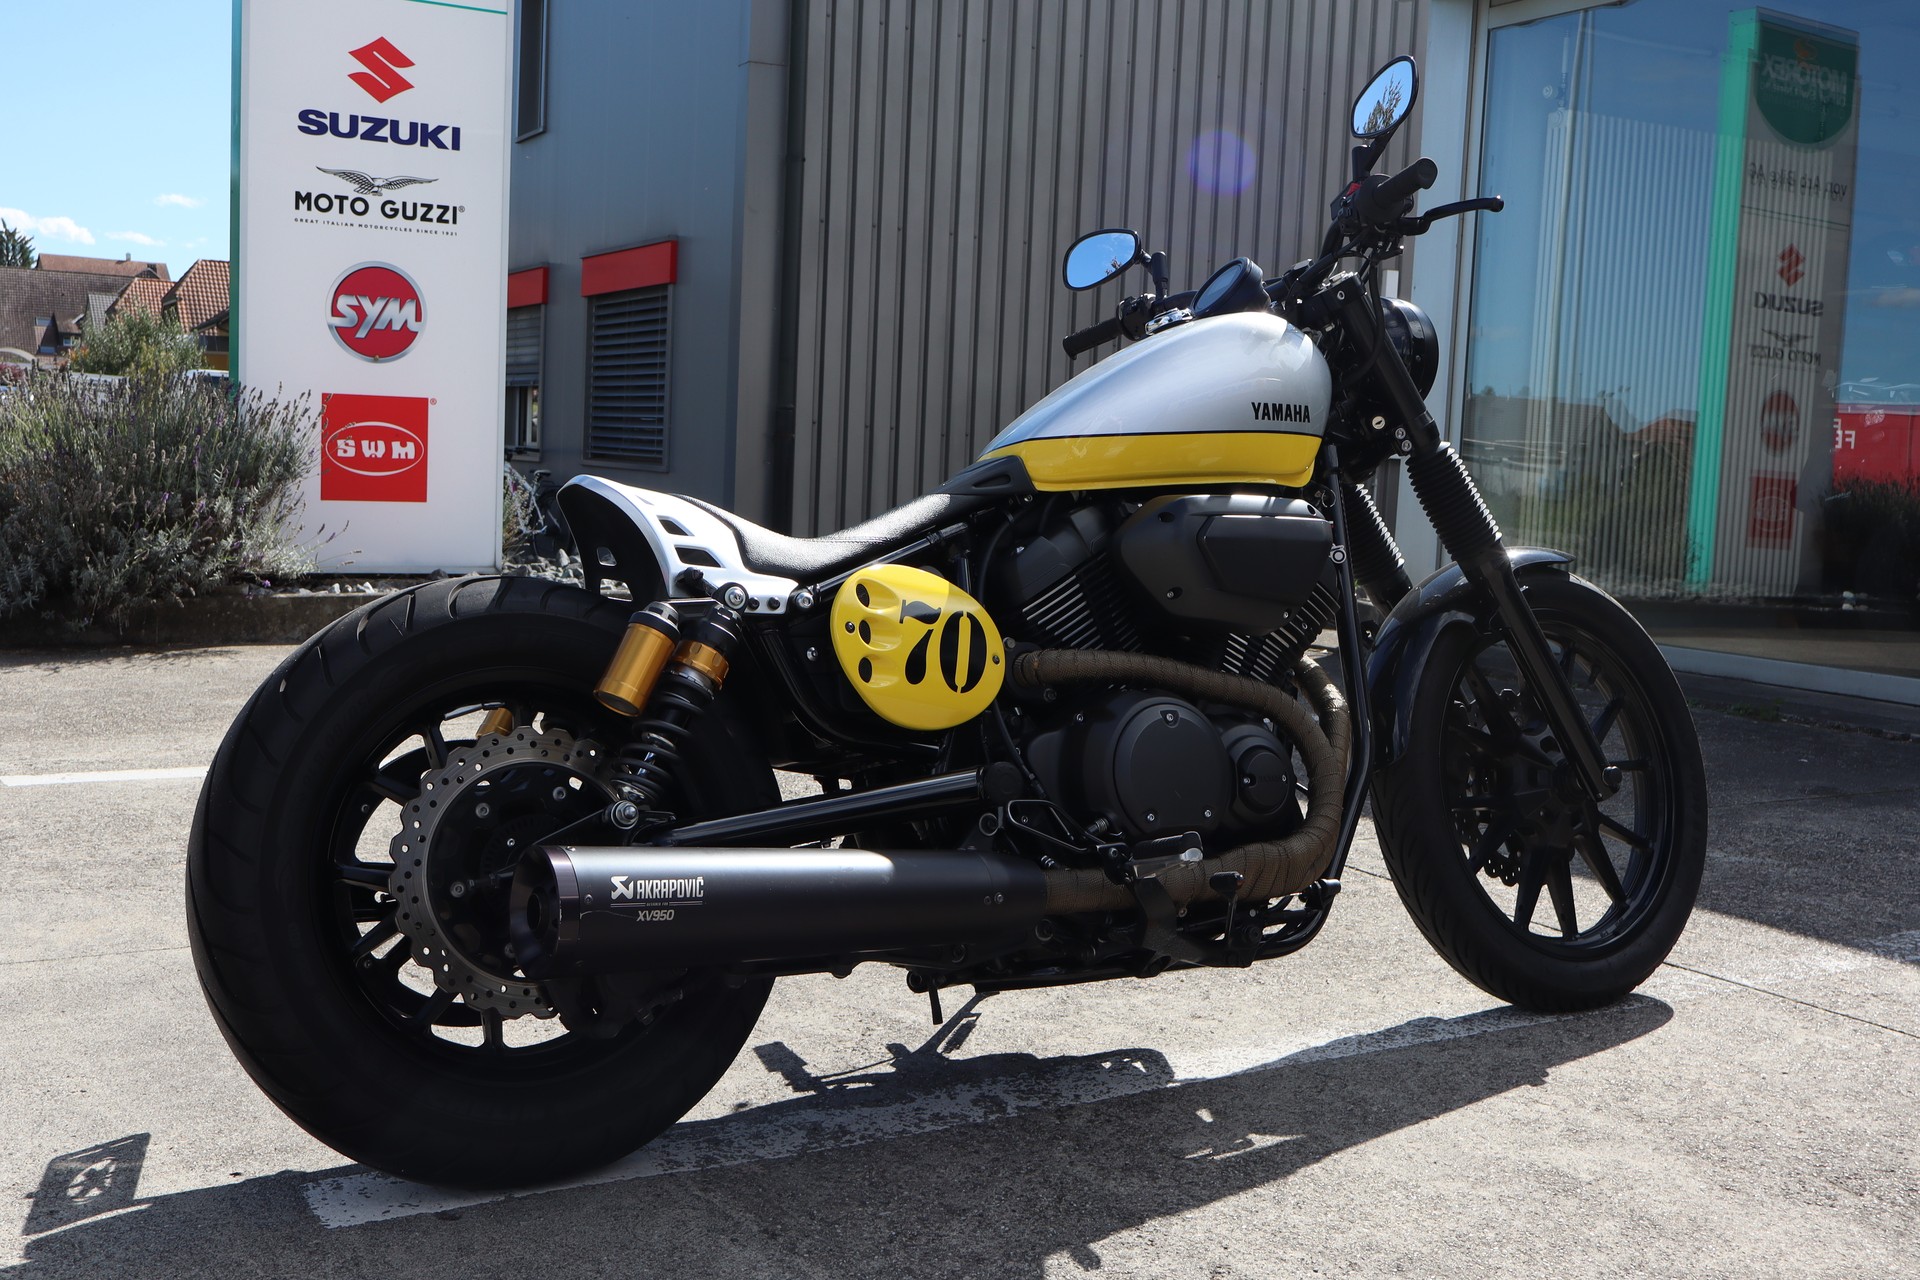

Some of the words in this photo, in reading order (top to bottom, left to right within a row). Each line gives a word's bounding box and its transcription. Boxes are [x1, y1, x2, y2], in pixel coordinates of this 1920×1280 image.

[297, 109, 461, 151] SUZUKI
[294, 190, 370, 216] MOTO
[358, 223, 413, 233] MOTORCYCLES
[329, 294, 422, 339] SYM
[1251, 402, 1311, 423] YAMAHA
[336, 438, 415, 460] SWM
[899, 599, 988, 694] 70
[636, 876, 704, 899] AKRAPOVIČ
[636, 909, 675, 922] XV950
